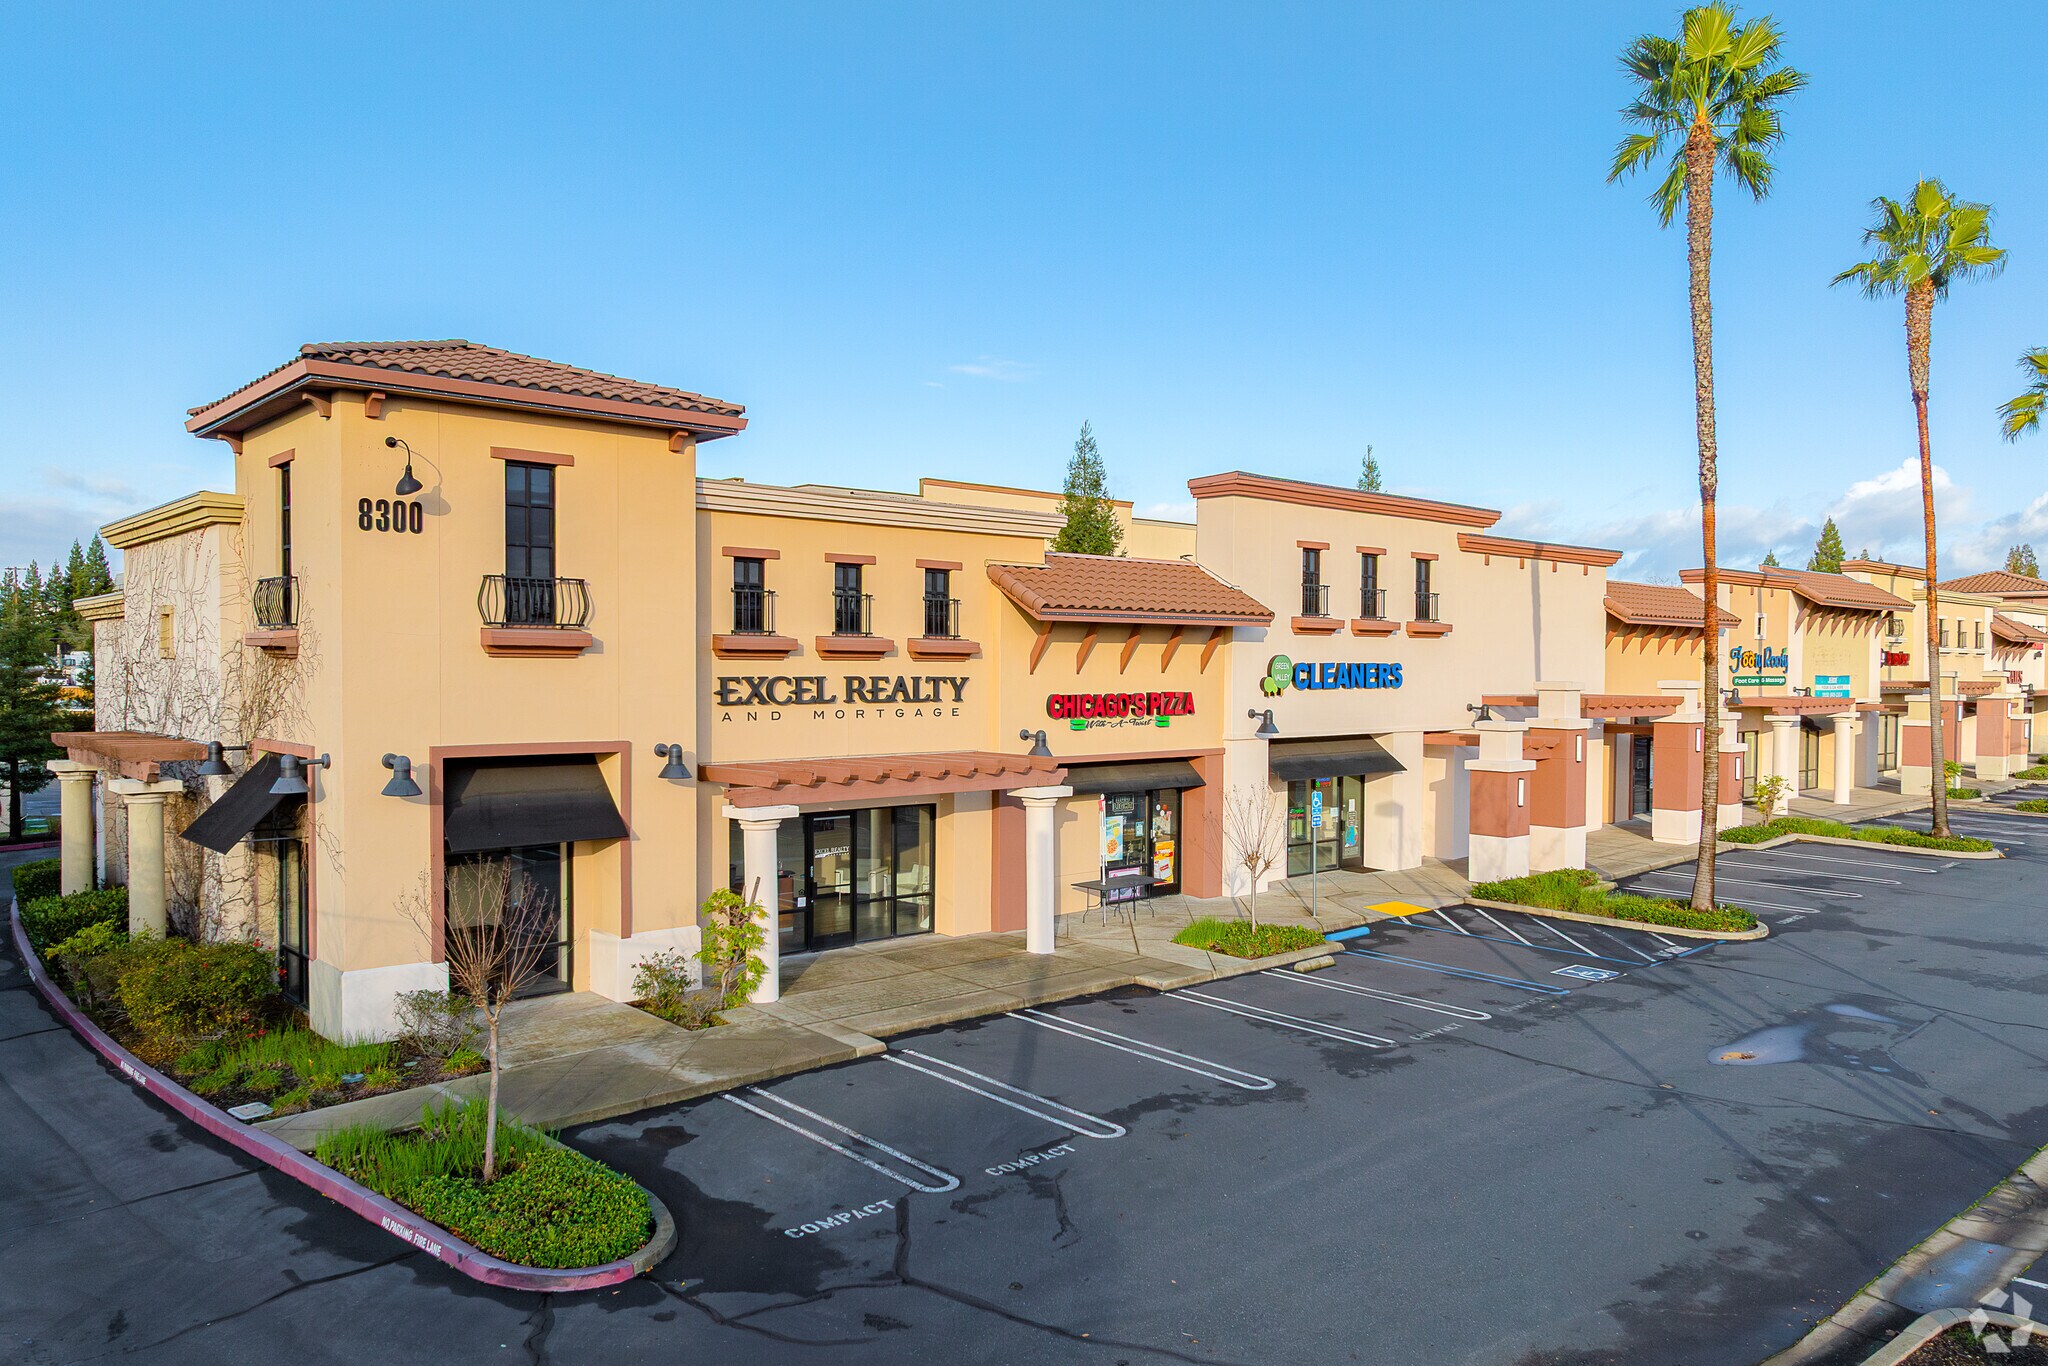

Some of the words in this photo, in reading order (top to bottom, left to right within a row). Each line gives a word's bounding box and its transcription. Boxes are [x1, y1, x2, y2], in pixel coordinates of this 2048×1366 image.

[358, 497, 423, 534] 8300
[1274, 673, 1290, 682] VALLEY
[1275, 662, 1289, 670] GREEN
[1294, 662, 1403, 690] CLEANERS
[714, 676, 838, 706] EXCEL
[843, 675, 969, 704] REALTY
[722, 711, 781, 722] AND
[813, 708, 960, 720] MORTGAGE
[1047, 693, 1147, 719] CHICAGO'S
[1147, 692, 1195, 716] PIZZA
[985, 1143, 1076, 1177] COMPACT
[784, 1199, 896, 1239] COMPACT
[381, 1216, 391, 1230] NO
[389, 1220, 413, 1241] PARKING
[413, 1233, 427, 1249] FIRE
[426, 1240, 442, 1257] LANE
